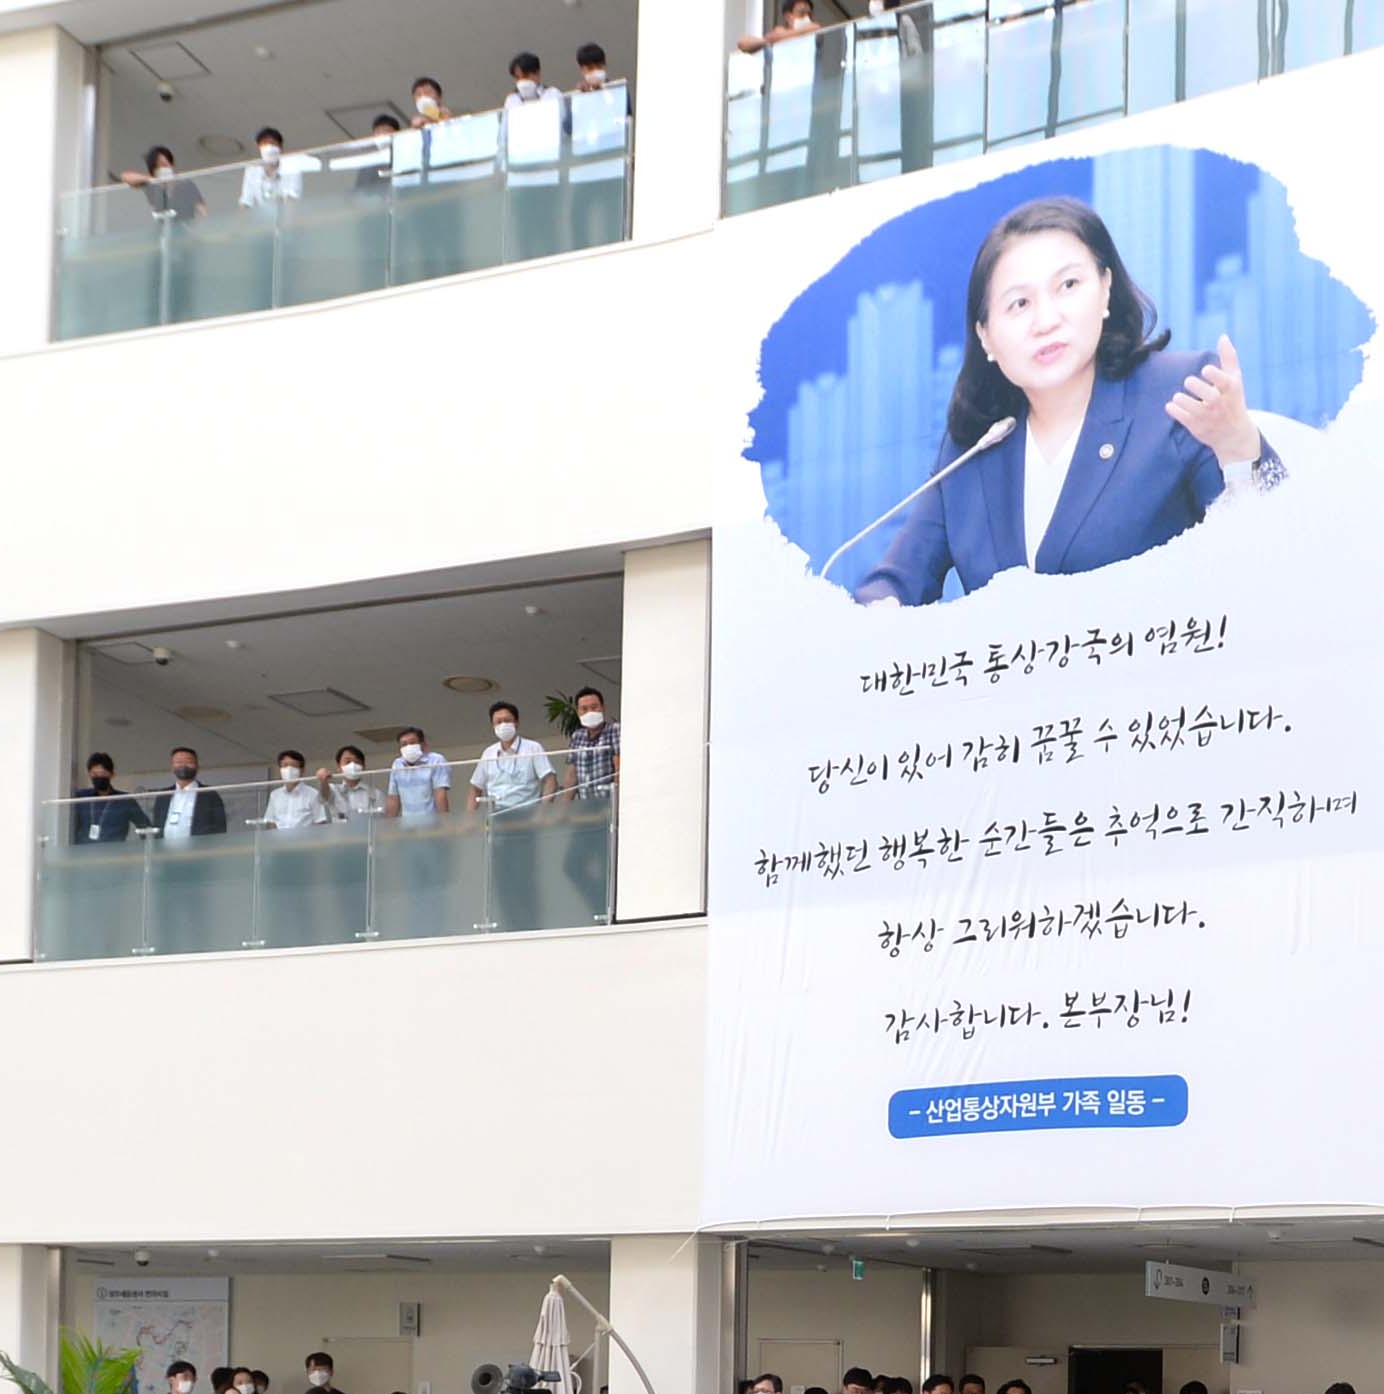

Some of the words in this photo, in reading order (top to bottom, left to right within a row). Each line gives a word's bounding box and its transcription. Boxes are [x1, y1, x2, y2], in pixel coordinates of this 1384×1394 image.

[860, 650, 974, 696] 대한민국
[983, 628, 1134, 684] 통상강국의
[1145, 615, 1227, 656] 염원!
[808, 752, 889, 794] 당신이
[897, 742, 953, 784] 있어
[962, 735, 1020, 773] 감히
[1031, 716, 1085, 765] 꿈꿀
[1093, 717, 1118, 753] 수
[1128, 704, 1293, 753] 있었습니다.
[754, 838, 872, 889] 함께했던
[877, 828, 971, 871] 행복한
[978, 810, 1096, 857] 순간들은
[1104, 803, 1210, 847] 추억으로
[1219, 790, 1358, 831] 간직하며
[877, 918, 945, 958] 항상
[951, 897, 1206, 945] 그리워하겠습니다.
[884, 1000, 1049, 1045] 감사합니다.
[1059, 988, 1192, 1029] 본부장님!
[925, 1090, 1057, 1125] 산업통상자원부
[1062, 1088, 1101, 1117] 가족
[1106, 1088, 1147, 1116] 일동
